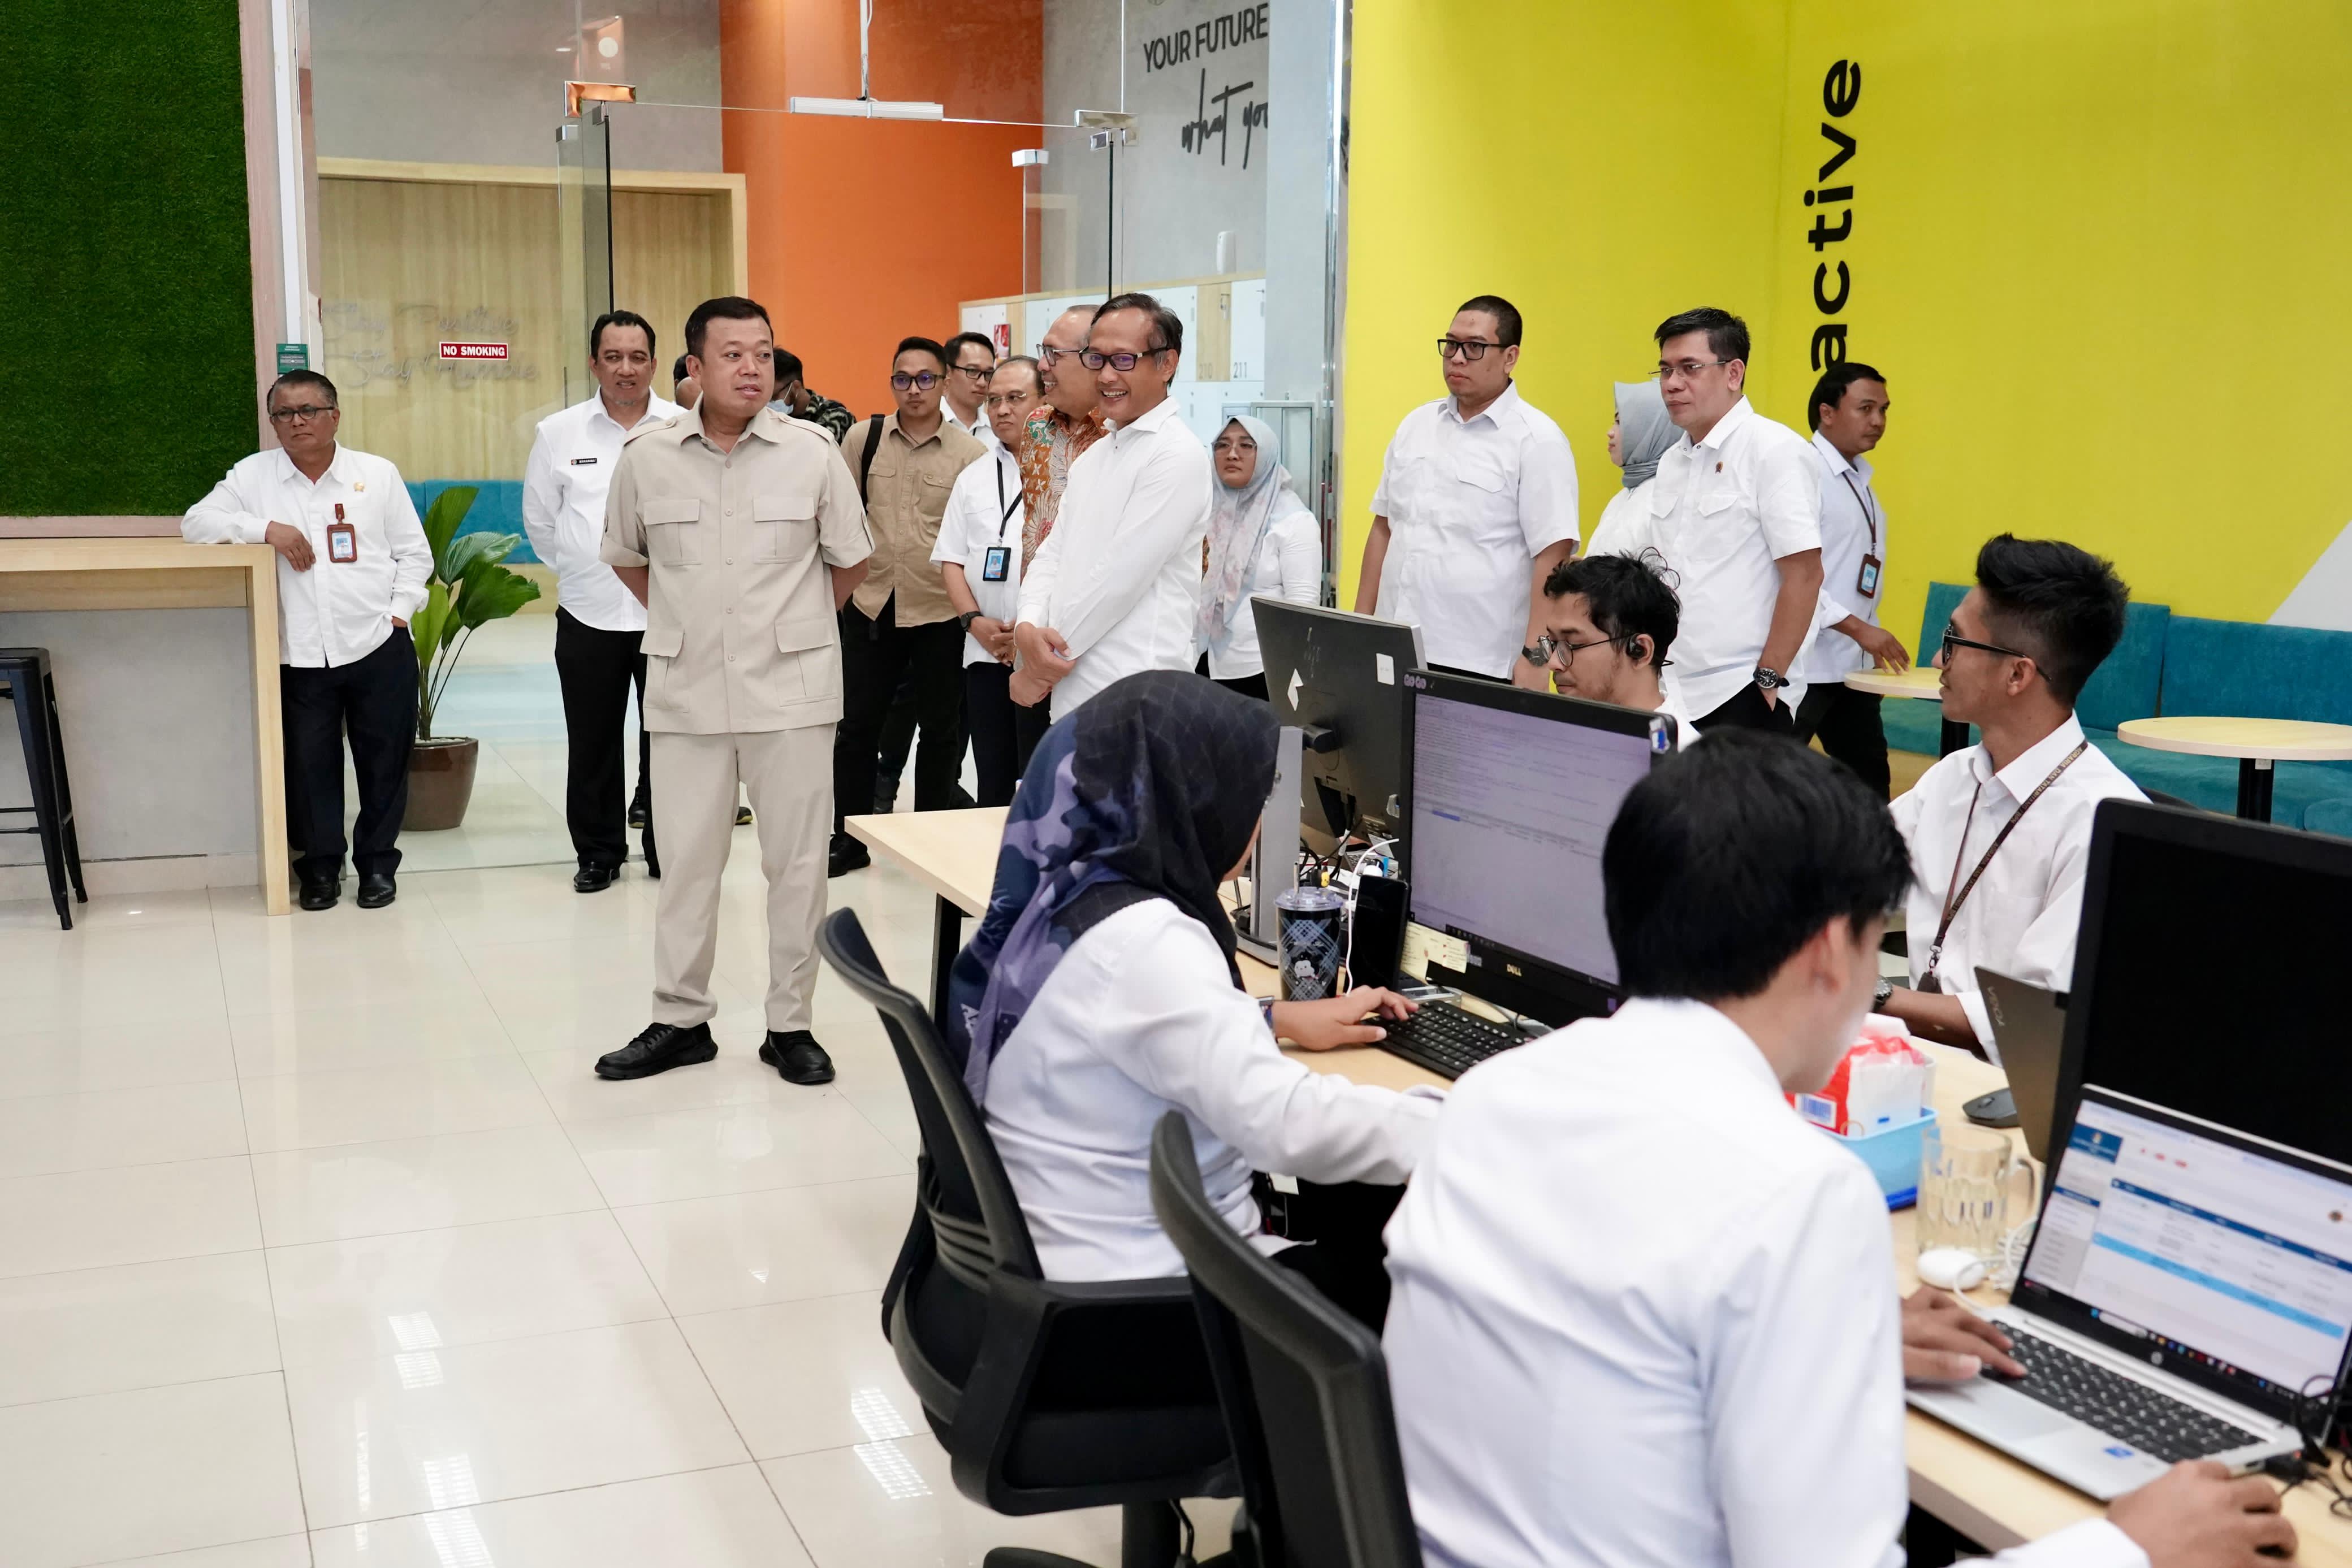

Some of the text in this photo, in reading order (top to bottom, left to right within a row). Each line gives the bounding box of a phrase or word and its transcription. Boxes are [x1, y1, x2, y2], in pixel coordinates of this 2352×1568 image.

[1144, 3, 1268, 72] YOUR FUTURE
[1804, 59, 1861, 373] active
[443, 345, 505, 356] NO SMOKING
[1233, 362, 1247, 378] 211
